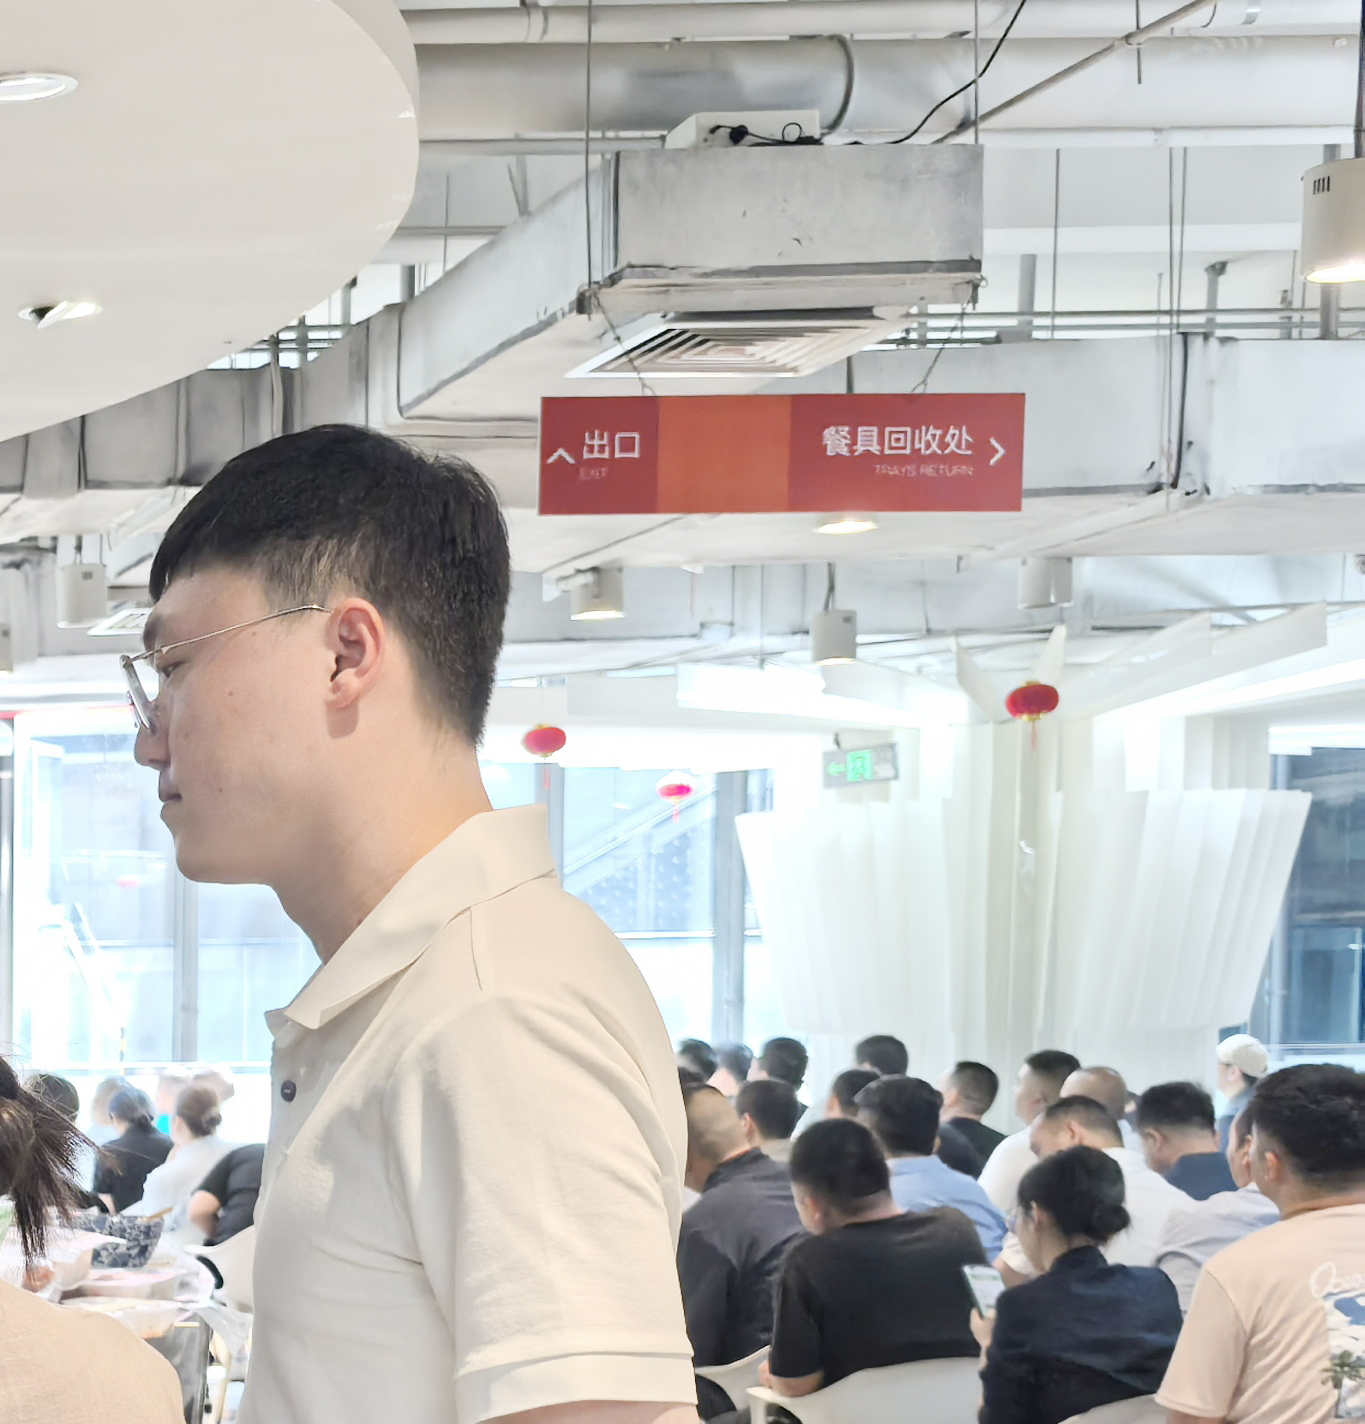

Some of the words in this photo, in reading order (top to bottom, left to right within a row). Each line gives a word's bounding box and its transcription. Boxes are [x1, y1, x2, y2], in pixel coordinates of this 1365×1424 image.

[582, 429, 640, 459] 出口
[821, 424, 973, 457] 餐具回收处
